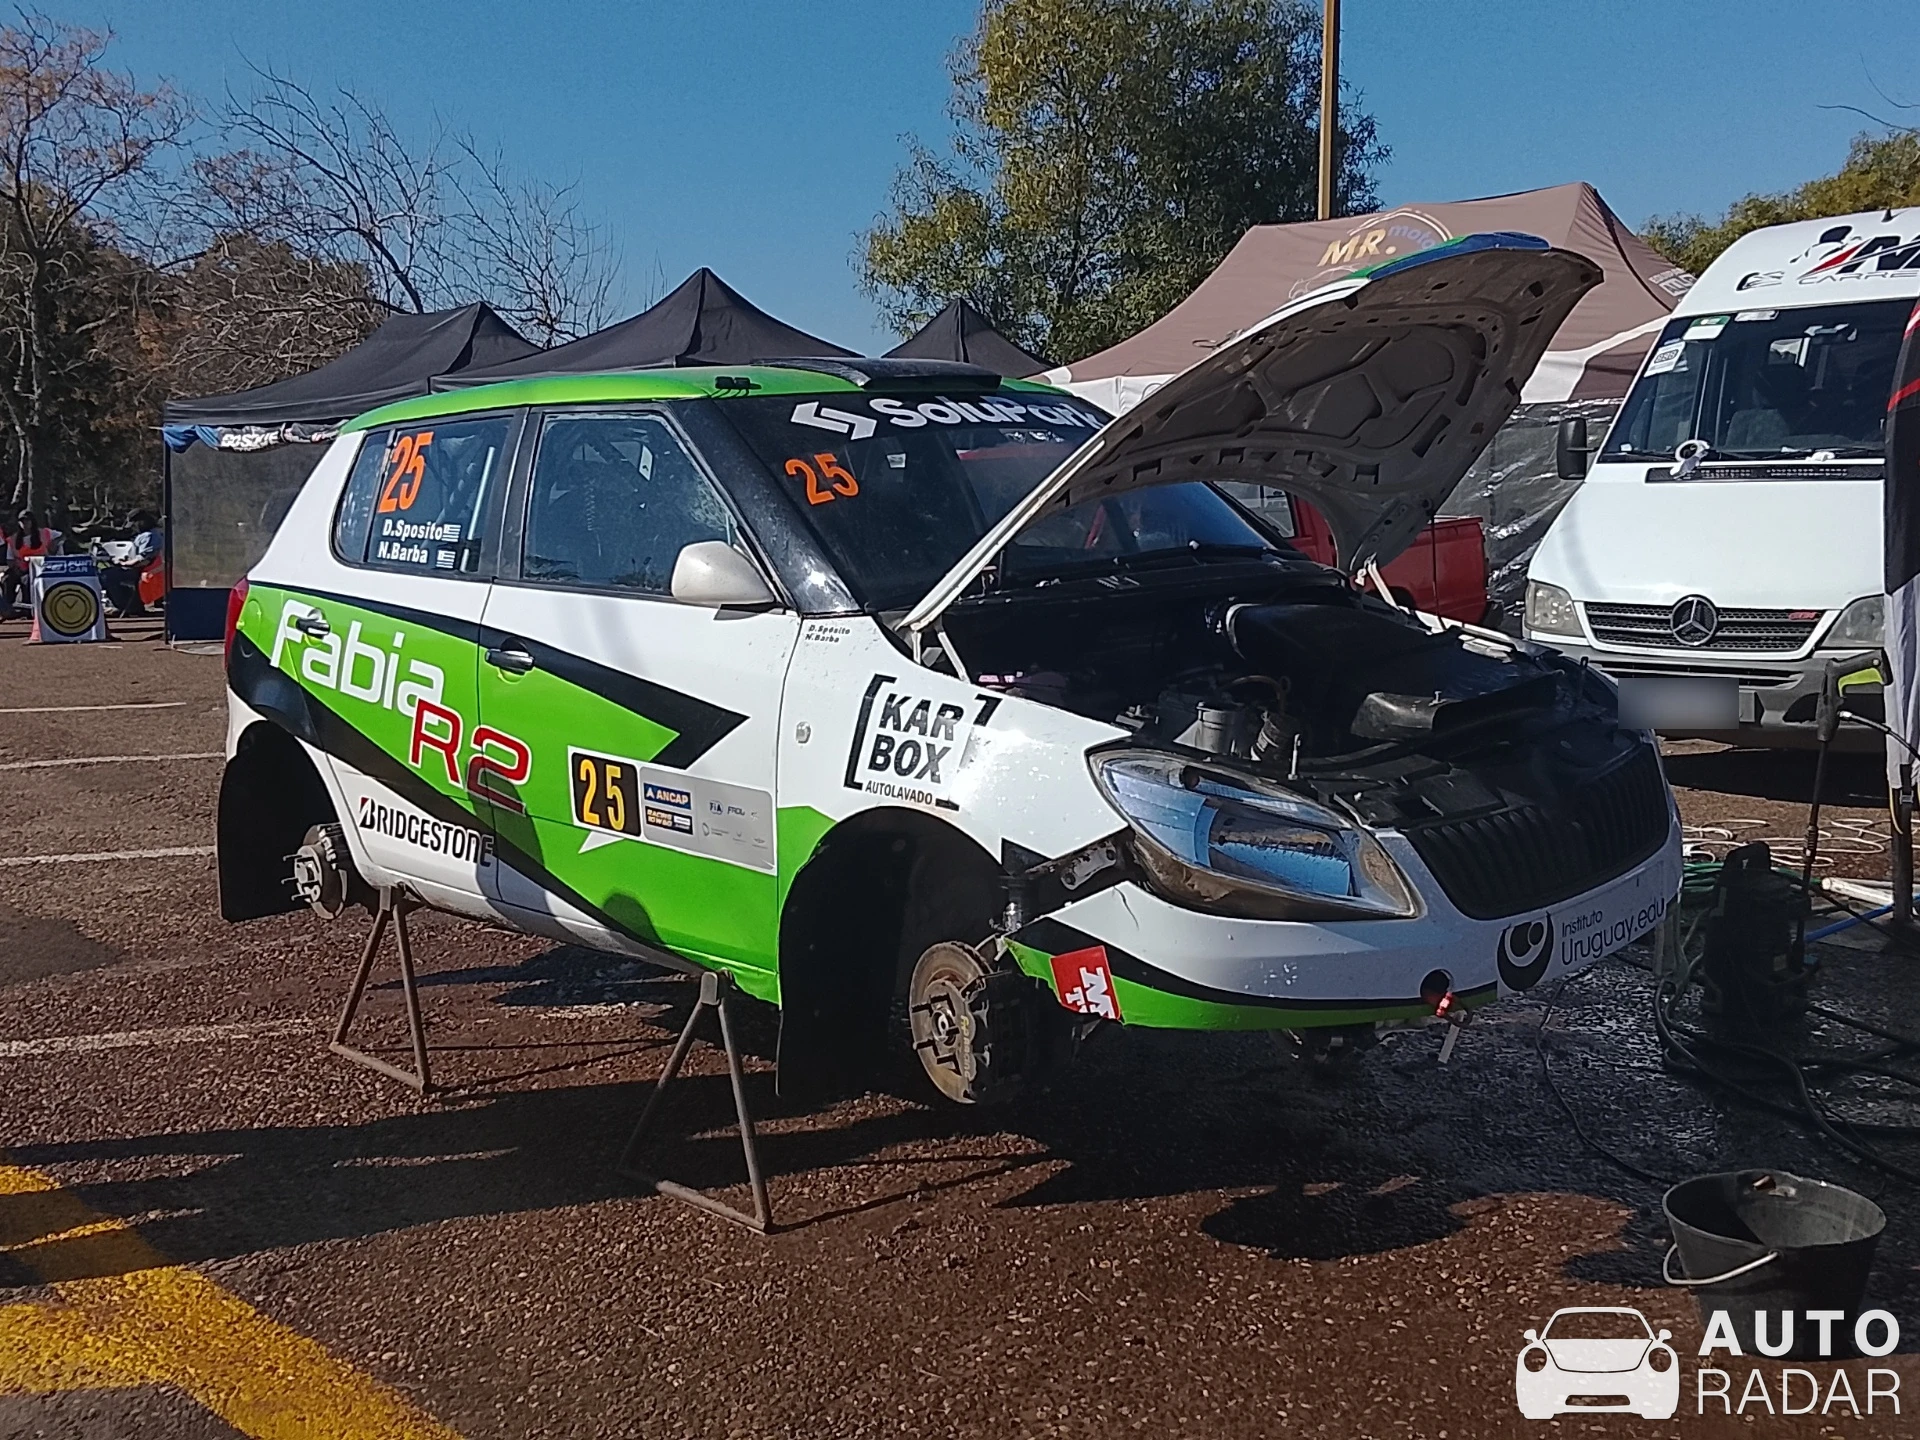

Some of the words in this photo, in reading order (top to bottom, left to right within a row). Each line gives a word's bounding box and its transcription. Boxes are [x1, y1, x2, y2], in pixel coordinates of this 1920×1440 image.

[1318, 228, 1396, 266] MR.
[378, 432, 434, 513] 25
[785, 453, 859, 505] 25
[377, 541, 428, 563] N.Barba
[382, 519, 443, 541] D.Sposito
[270, 599, 444, 726] Fabia
[879, 693, 964, 741] KAR
[409, 698, 532, 816] R2
[868, 734, 951, 784] BOX
[579, 758, 625, 831] 25
[656, 792, 689, 805] ANCAP
[865, 780, 933, 806] AUTOLAVADO
[1561, 897, 1665, 966] Uruguay.edu
[1562, 910, 1603, 938] Instituto
